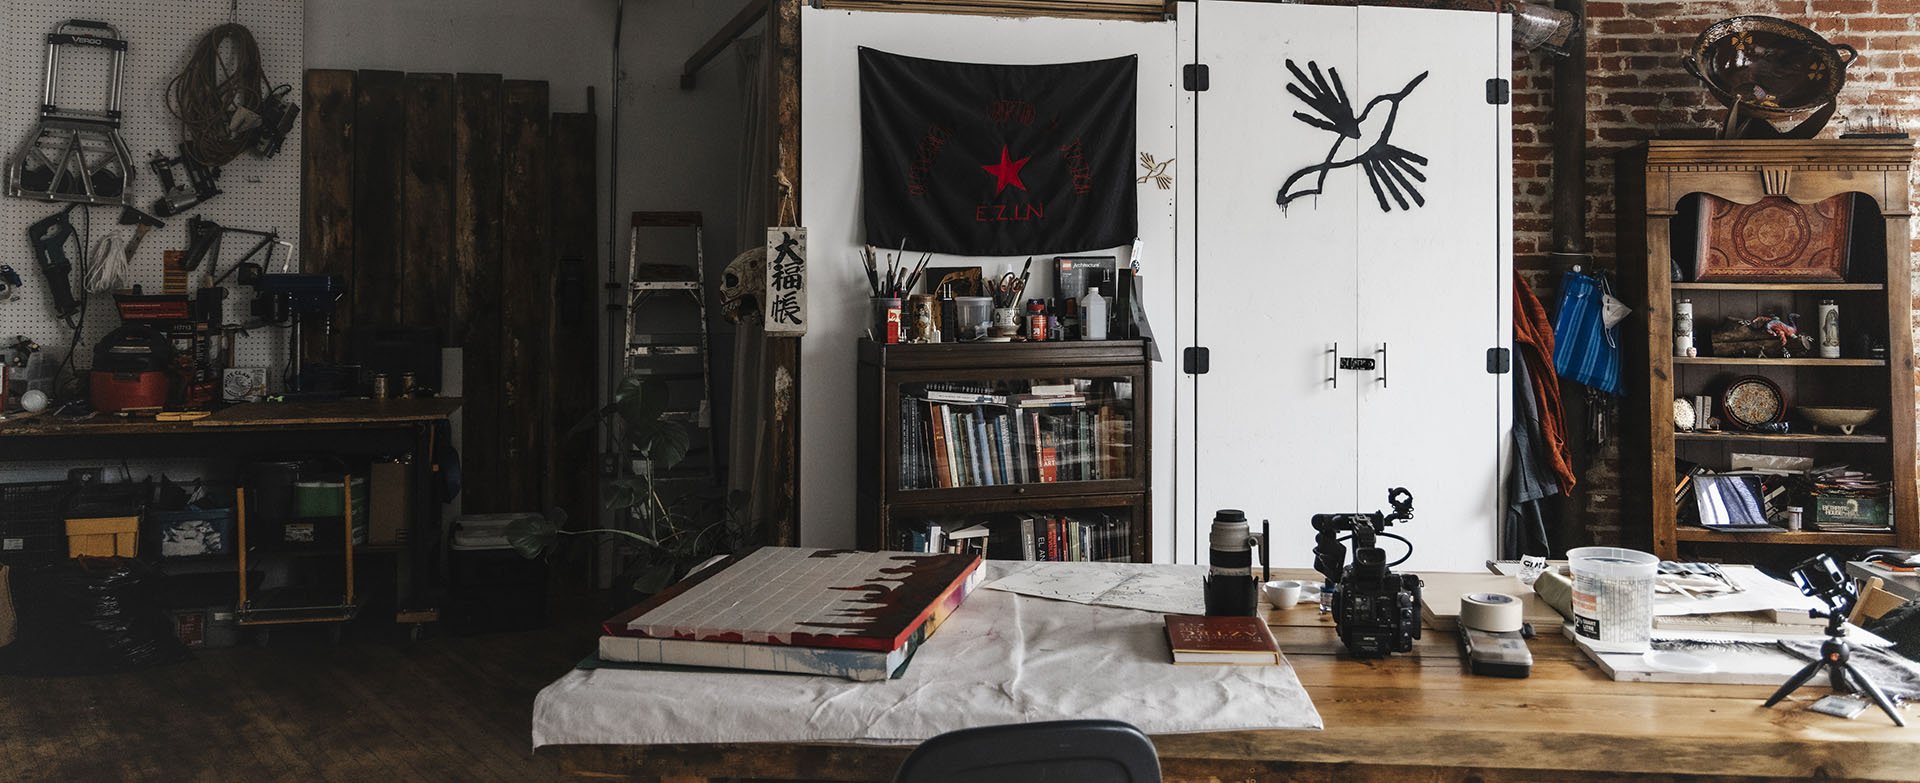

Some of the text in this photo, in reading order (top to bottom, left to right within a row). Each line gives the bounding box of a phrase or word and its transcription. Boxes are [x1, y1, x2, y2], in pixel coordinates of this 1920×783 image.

[71, 36, 102, 45] VERGO
[1072, 262, 1099, 270] Architecture
[771, 231, 804, 325] 大福帳
